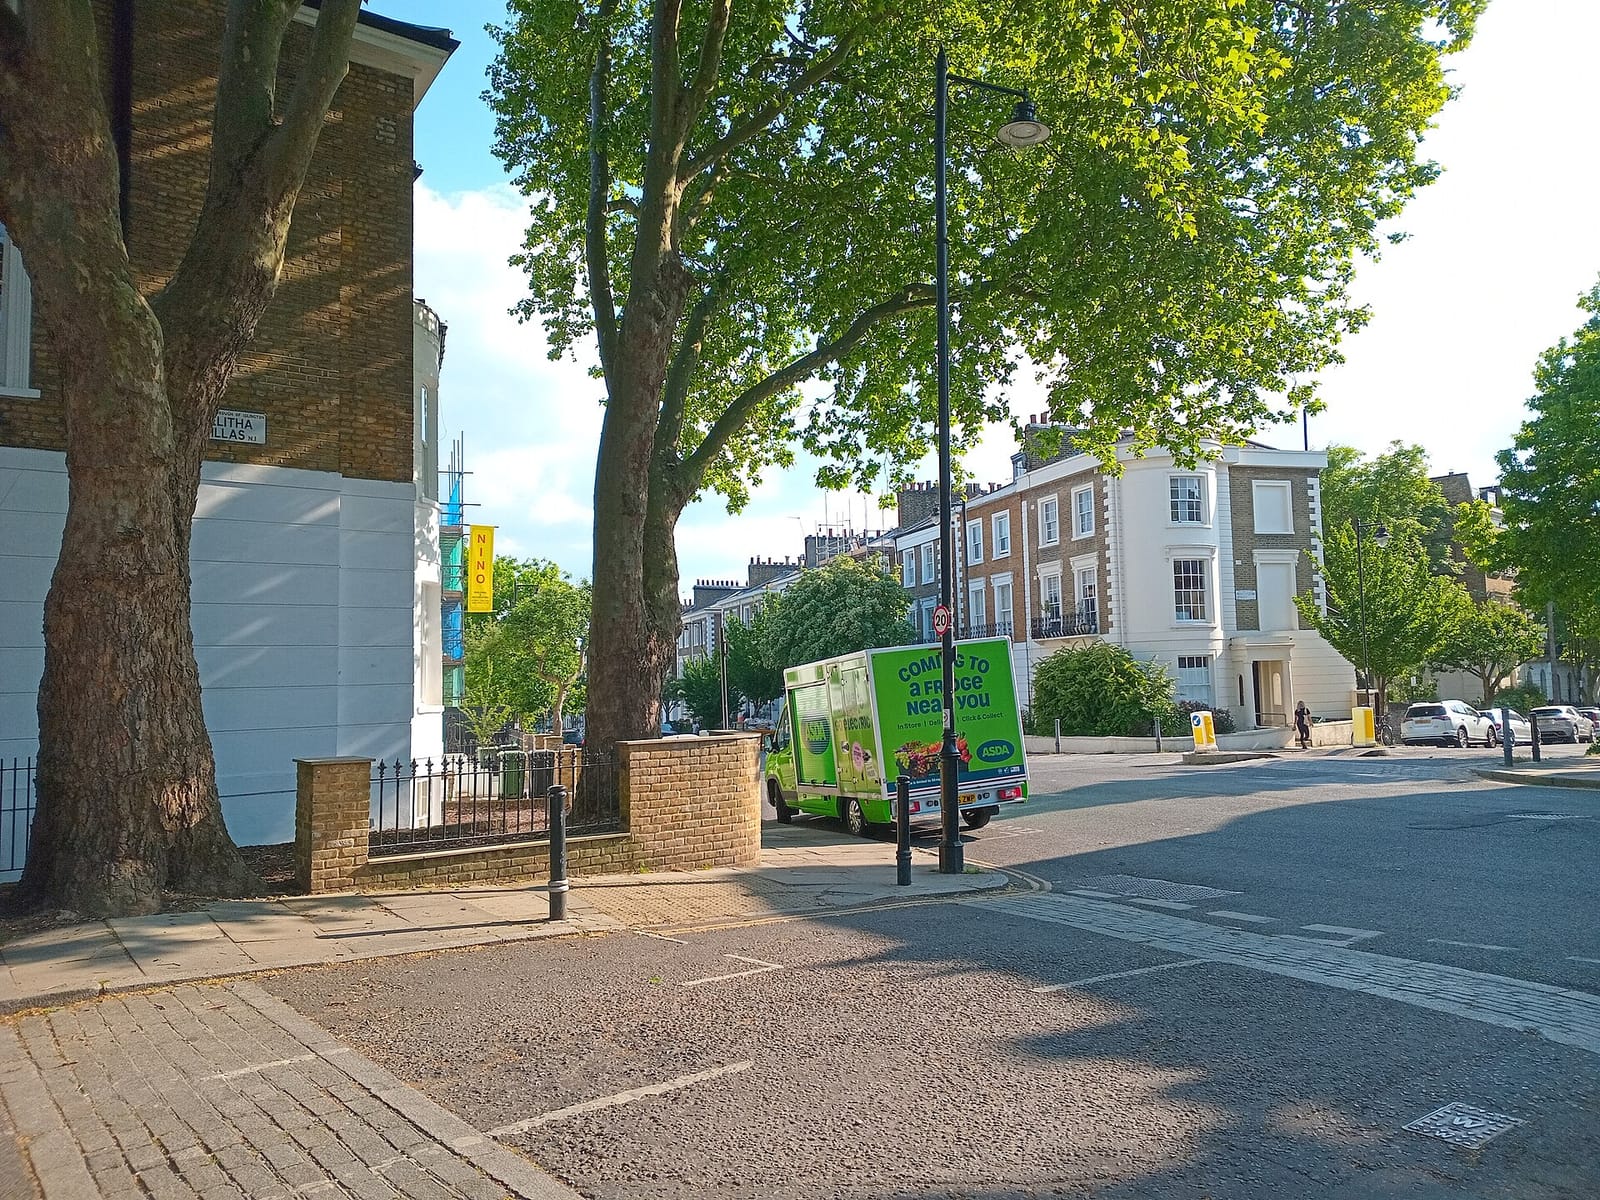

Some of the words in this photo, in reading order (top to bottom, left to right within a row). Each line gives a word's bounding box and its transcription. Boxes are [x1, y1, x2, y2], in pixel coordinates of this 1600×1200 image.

[213, 416, 253, 430] LITHA
[211, 427, 246, 441] ILLAS
[476, 533, 486, 584] NINO
[935, 614, 947, 627] 20
[898, 652, 965, 682] COMIG
[969, 655, 990, 674] TO
[906, 698, 943, 716] Nea
[982, 712, 1003, 720] Collect
[982, 745, 1010, 757] ASDA
